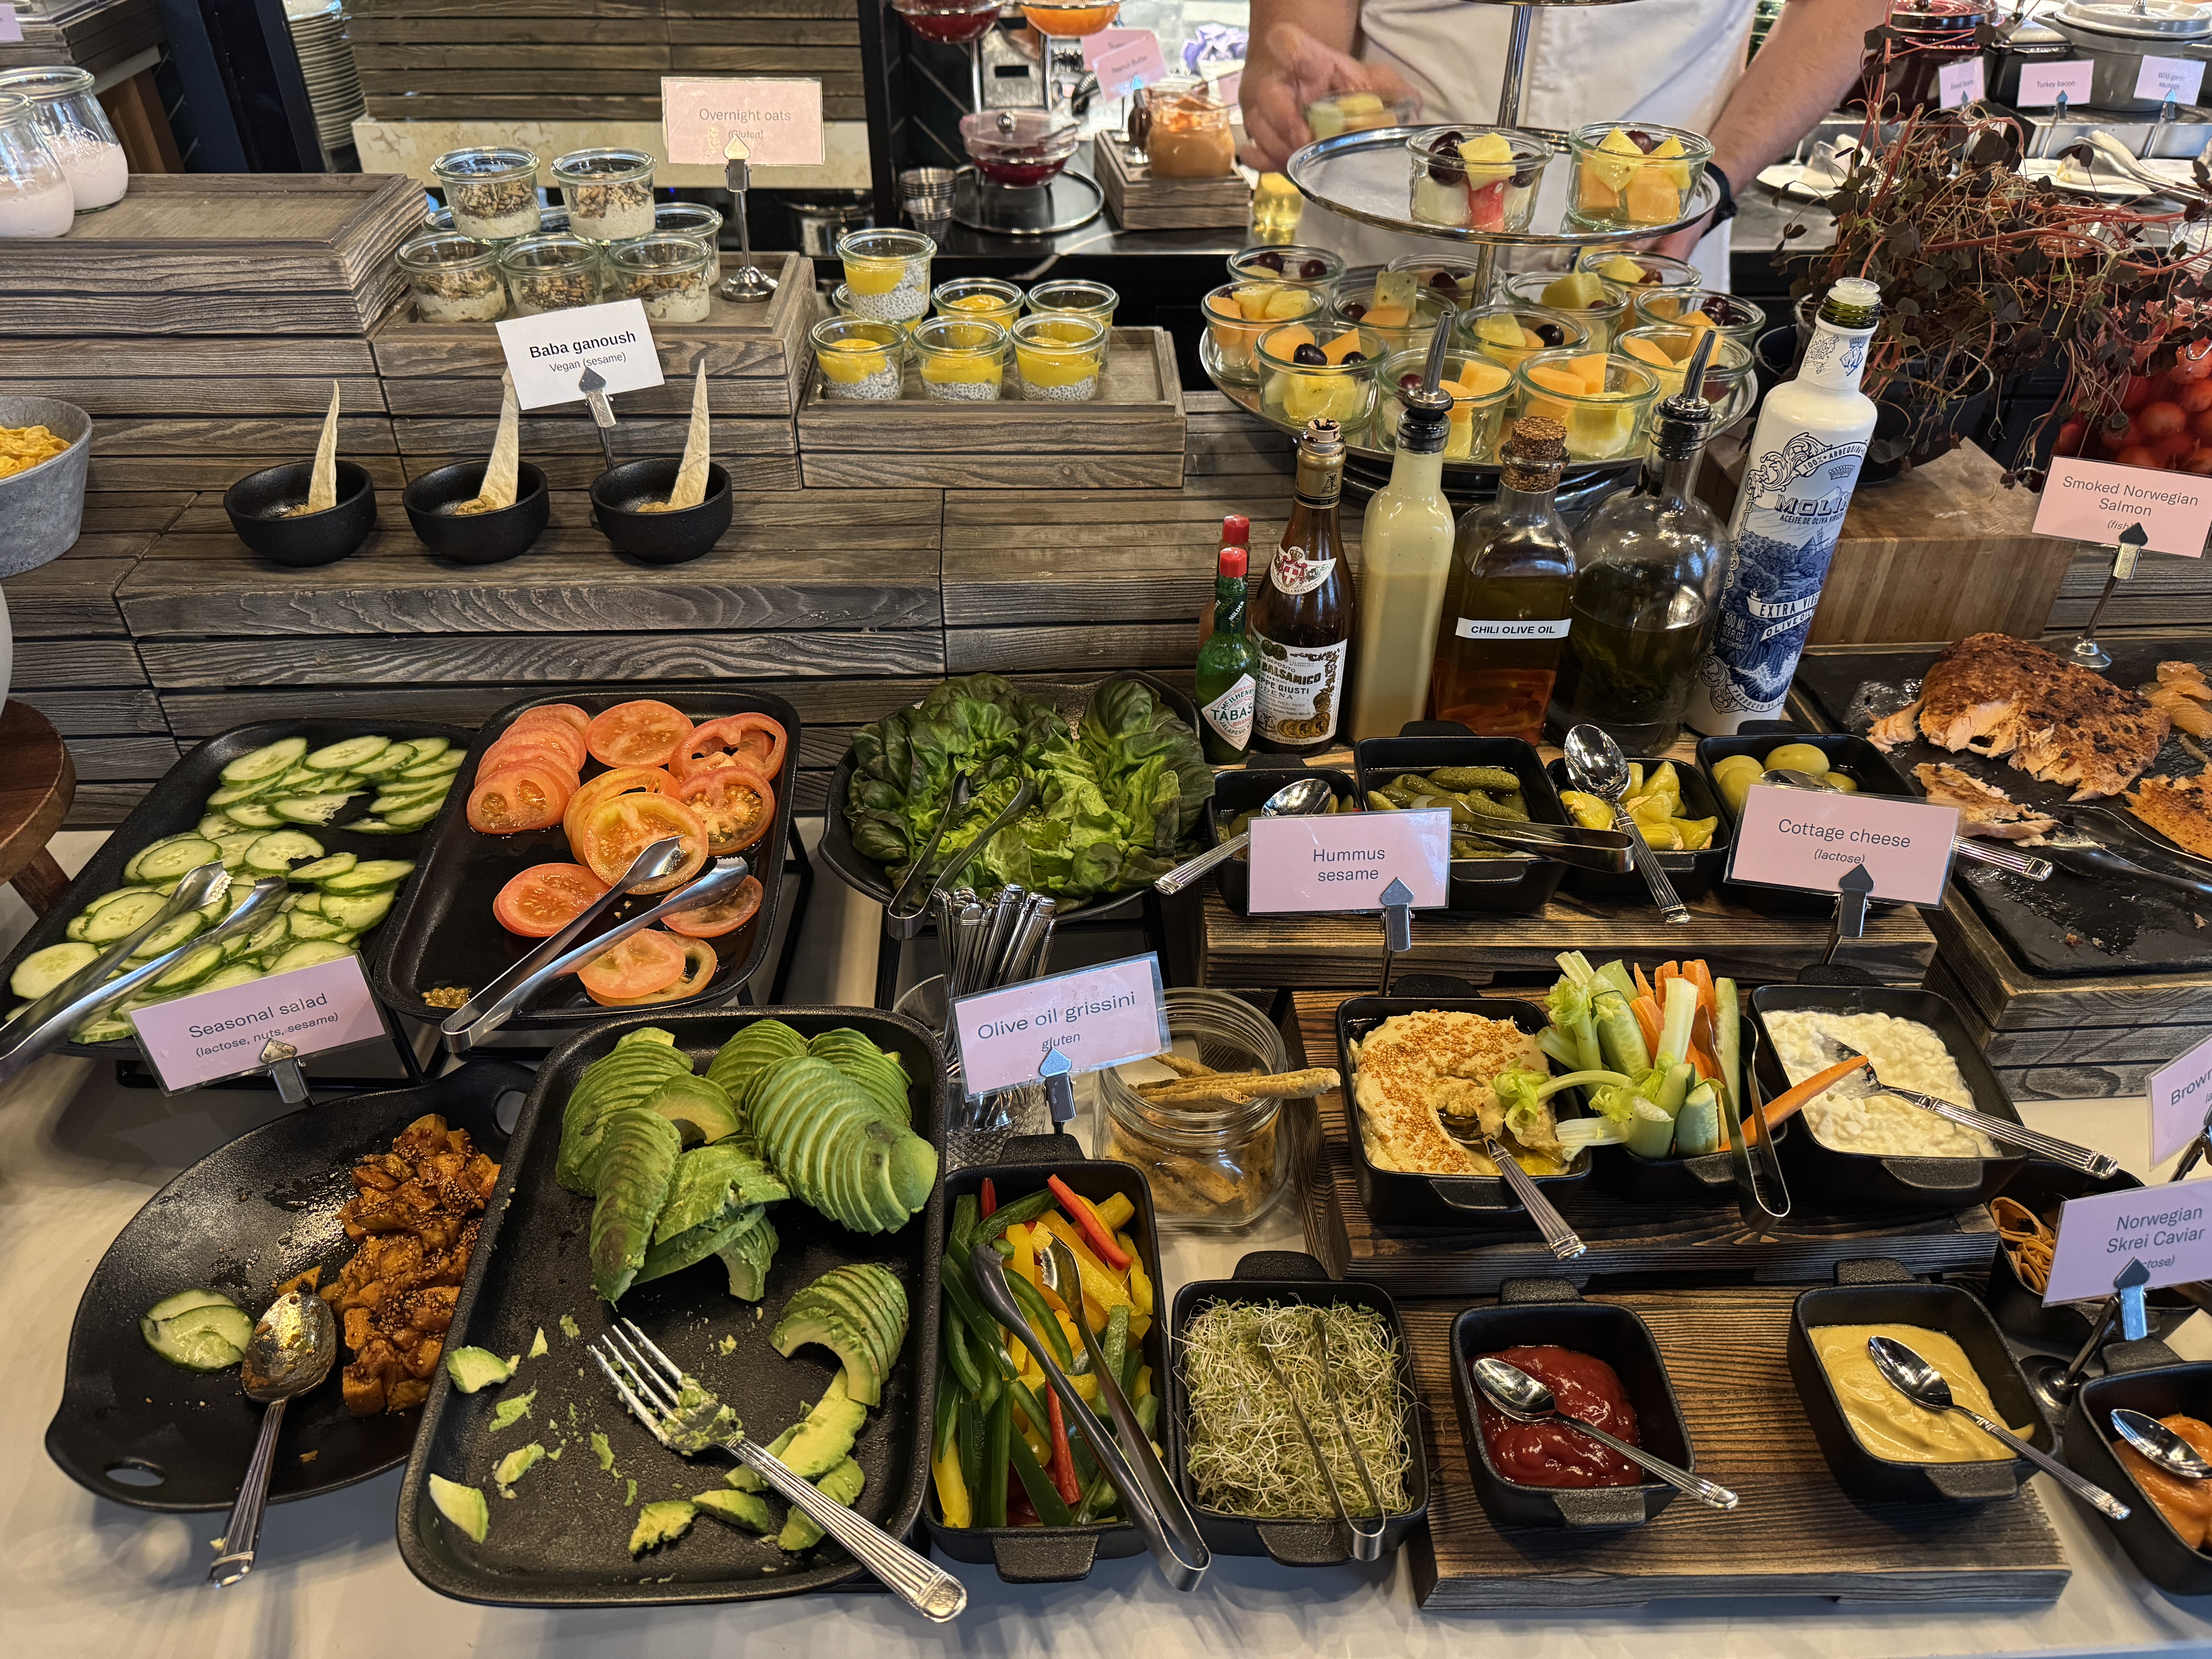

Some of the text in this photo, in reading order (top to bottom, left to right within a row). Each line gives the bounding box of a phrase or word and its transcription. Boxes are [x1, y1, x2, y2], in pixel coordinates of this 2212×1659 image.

[2037, 81, 2056, 89] Turkey
[699, 108, 791, 123] Overnight oats
[529, 331, 636, 358] Baba ganoush
[549, 352, 626, 373] Vegan (sesame)
[2063, 476, 2198, 506] Smoked Norwegian
[2099, 498, 2152, 516] Salmon
[1779, 514, 1801, 524] ACEITE
[1812, 517, 1828, 525] OLIVA
[1228, 601, 1245, 622] MILDER
[1759, 602, 1796, 617] EXTRA
[1724, 613, 1747, 632] 500 ML
[1766, 616, 1798, 637] OLIVE
[1726, 640, 1745, 650] CONTENT
[1736, 632, 1745, 642] OZ
[1262, 661, 1321, 685] BALSAMICO
[1267, 658, 1296, 673] DEPOSITO
[1257, 683, 1293, 700] ODENA
[1278, 685, 1309, 694] GIUSTI
[1732, 689, 1764, 710] PRODUCTO
[1211, 702, 1252, 721] TABAS
[1233, 716, 1251, 726] BRAND
[1778, 819, 1910, 848] Cottage cheese
[1313, 848, 1385, 863] Hummus
[1814, 848, 1865, 864] (lactose)
[1317, 869, 1379, 882] sesame
[188, 993, 328, 1039] Seasonal salad
[977, 991, 1135, 1039] Olive oil grissini
[196, 1012, 338, 1058] (lactose, nuts, sesame)
[1041, 1033, 1080, 1051] gluten
[2116, 1207, 2203, 1231] Norwegian
[2106, 1227, 2207, 1253] Skrei Caviar
